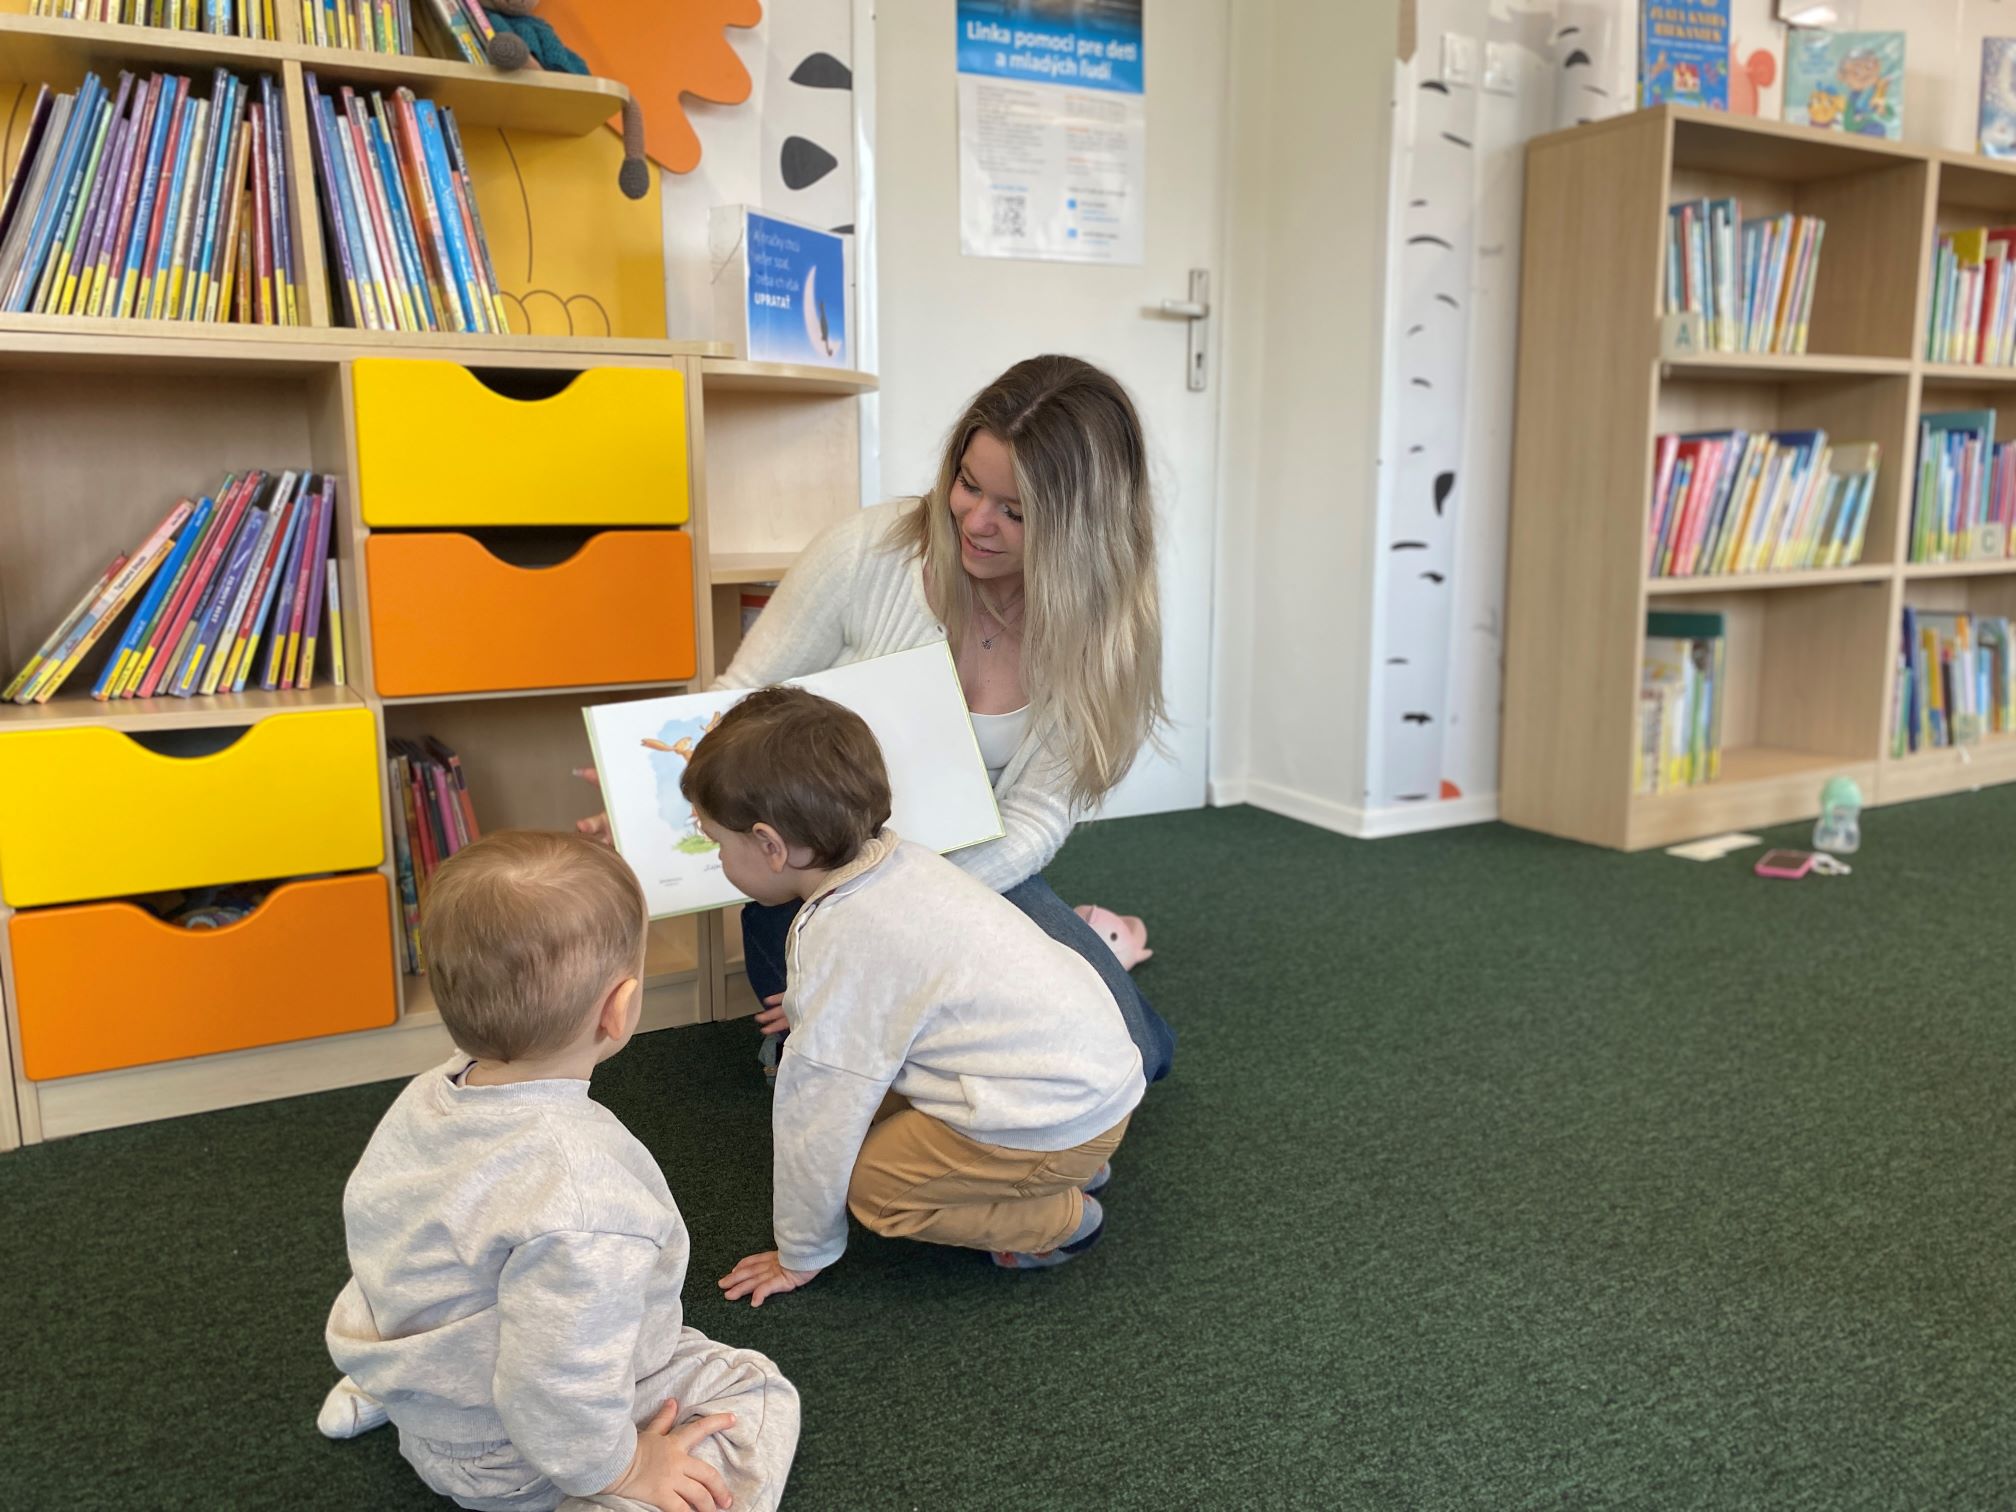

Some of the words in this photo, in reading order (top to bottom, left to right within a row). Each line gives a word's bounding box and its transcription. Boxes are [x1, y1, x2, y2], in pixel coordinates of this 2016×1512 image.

[966, 21, 1011, 44] Linka
[1014, 31, 1075, 52] pomoci
[1077, 40, 1103, 57] pre
[1106, 39, 1137, 61] deti
[995, 52, 1006, 67] a
[1009, 51, 1077, 77] mladých
